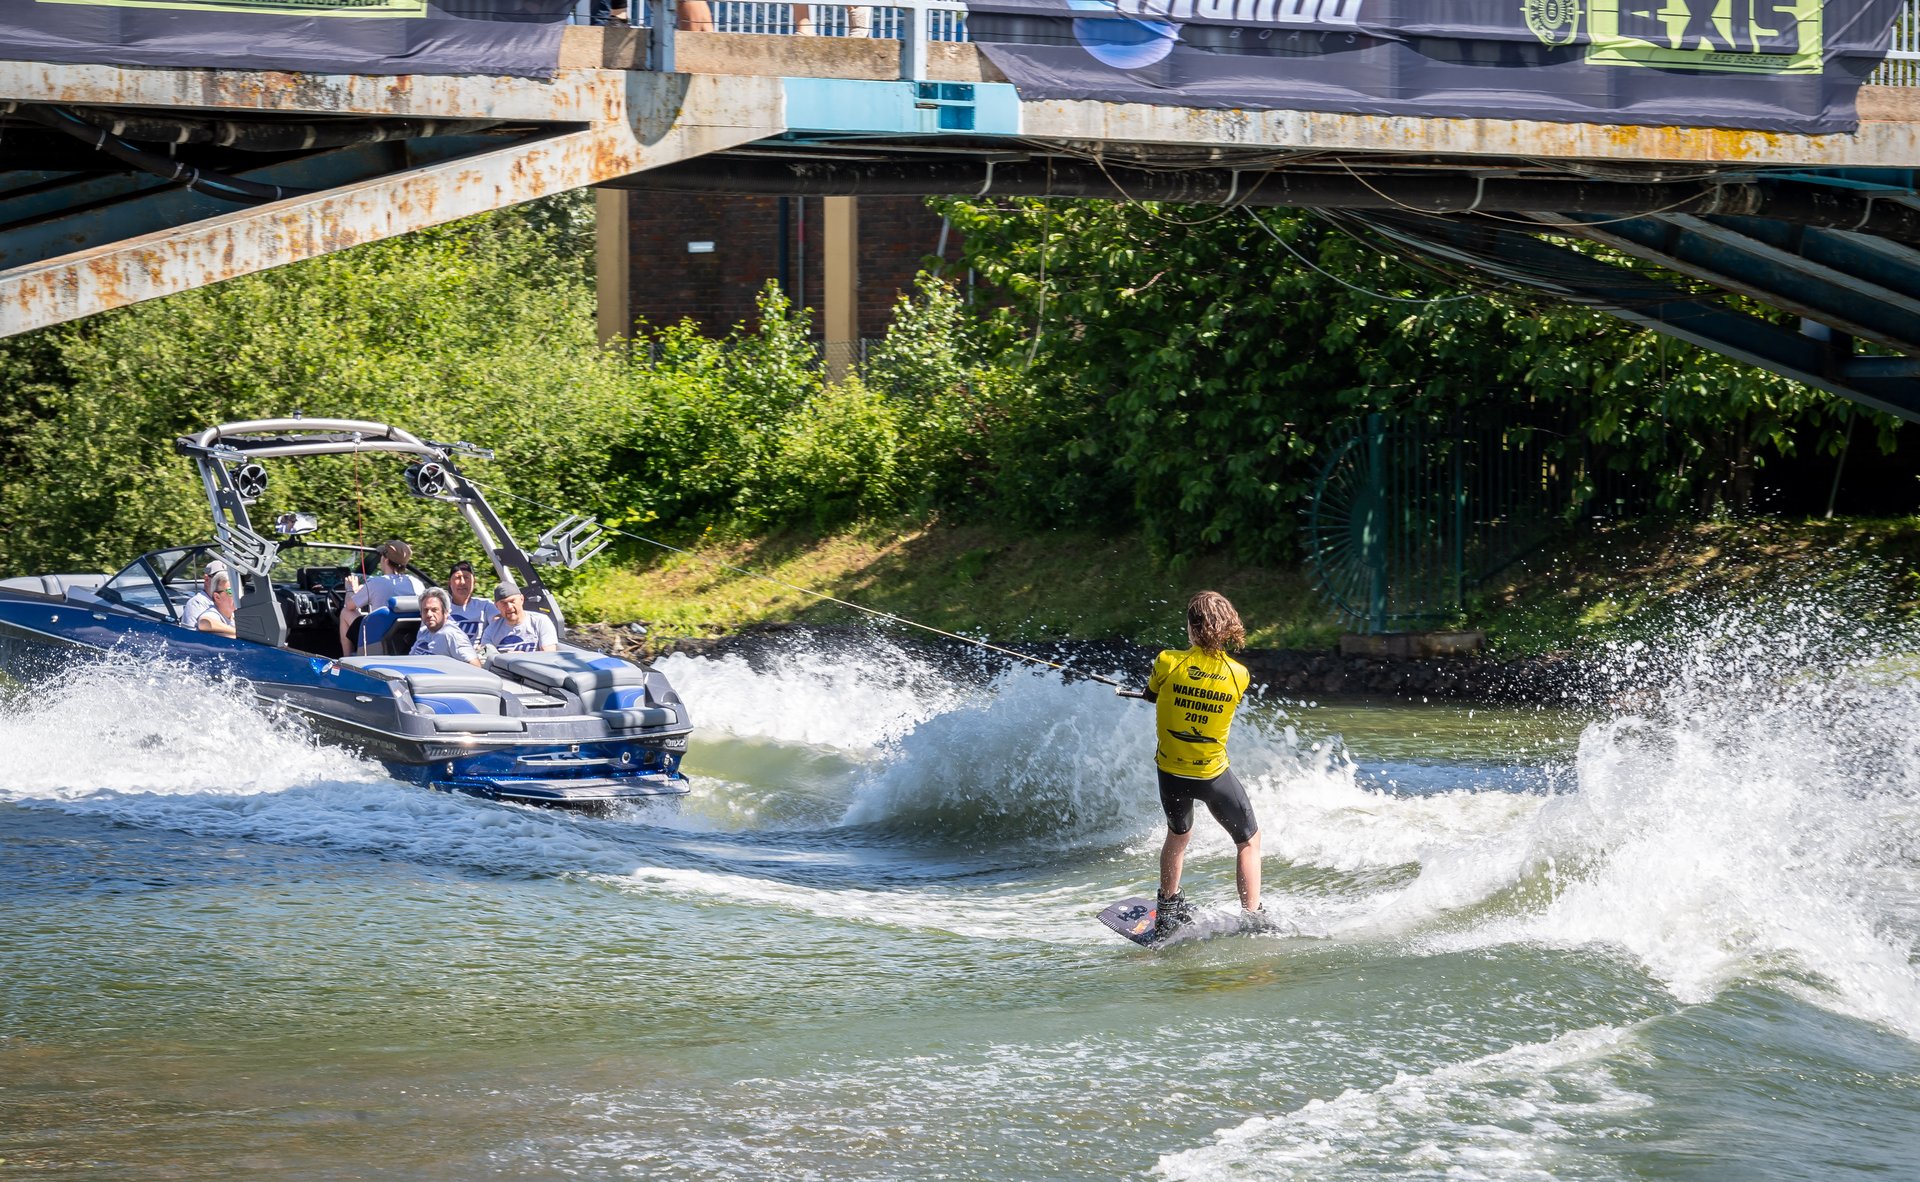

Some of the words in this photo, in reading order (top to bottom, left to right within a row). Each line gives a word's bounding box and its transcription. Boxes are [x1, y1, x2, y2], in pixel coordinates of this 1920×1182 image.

[1229, 27, 1358, 44] BOATS
[1173, 683, 1233, 702] WAKEBOARD
[1174, 697, 1224, 714] NATIONALS
[1184, 712, 1209, 725] 2019
